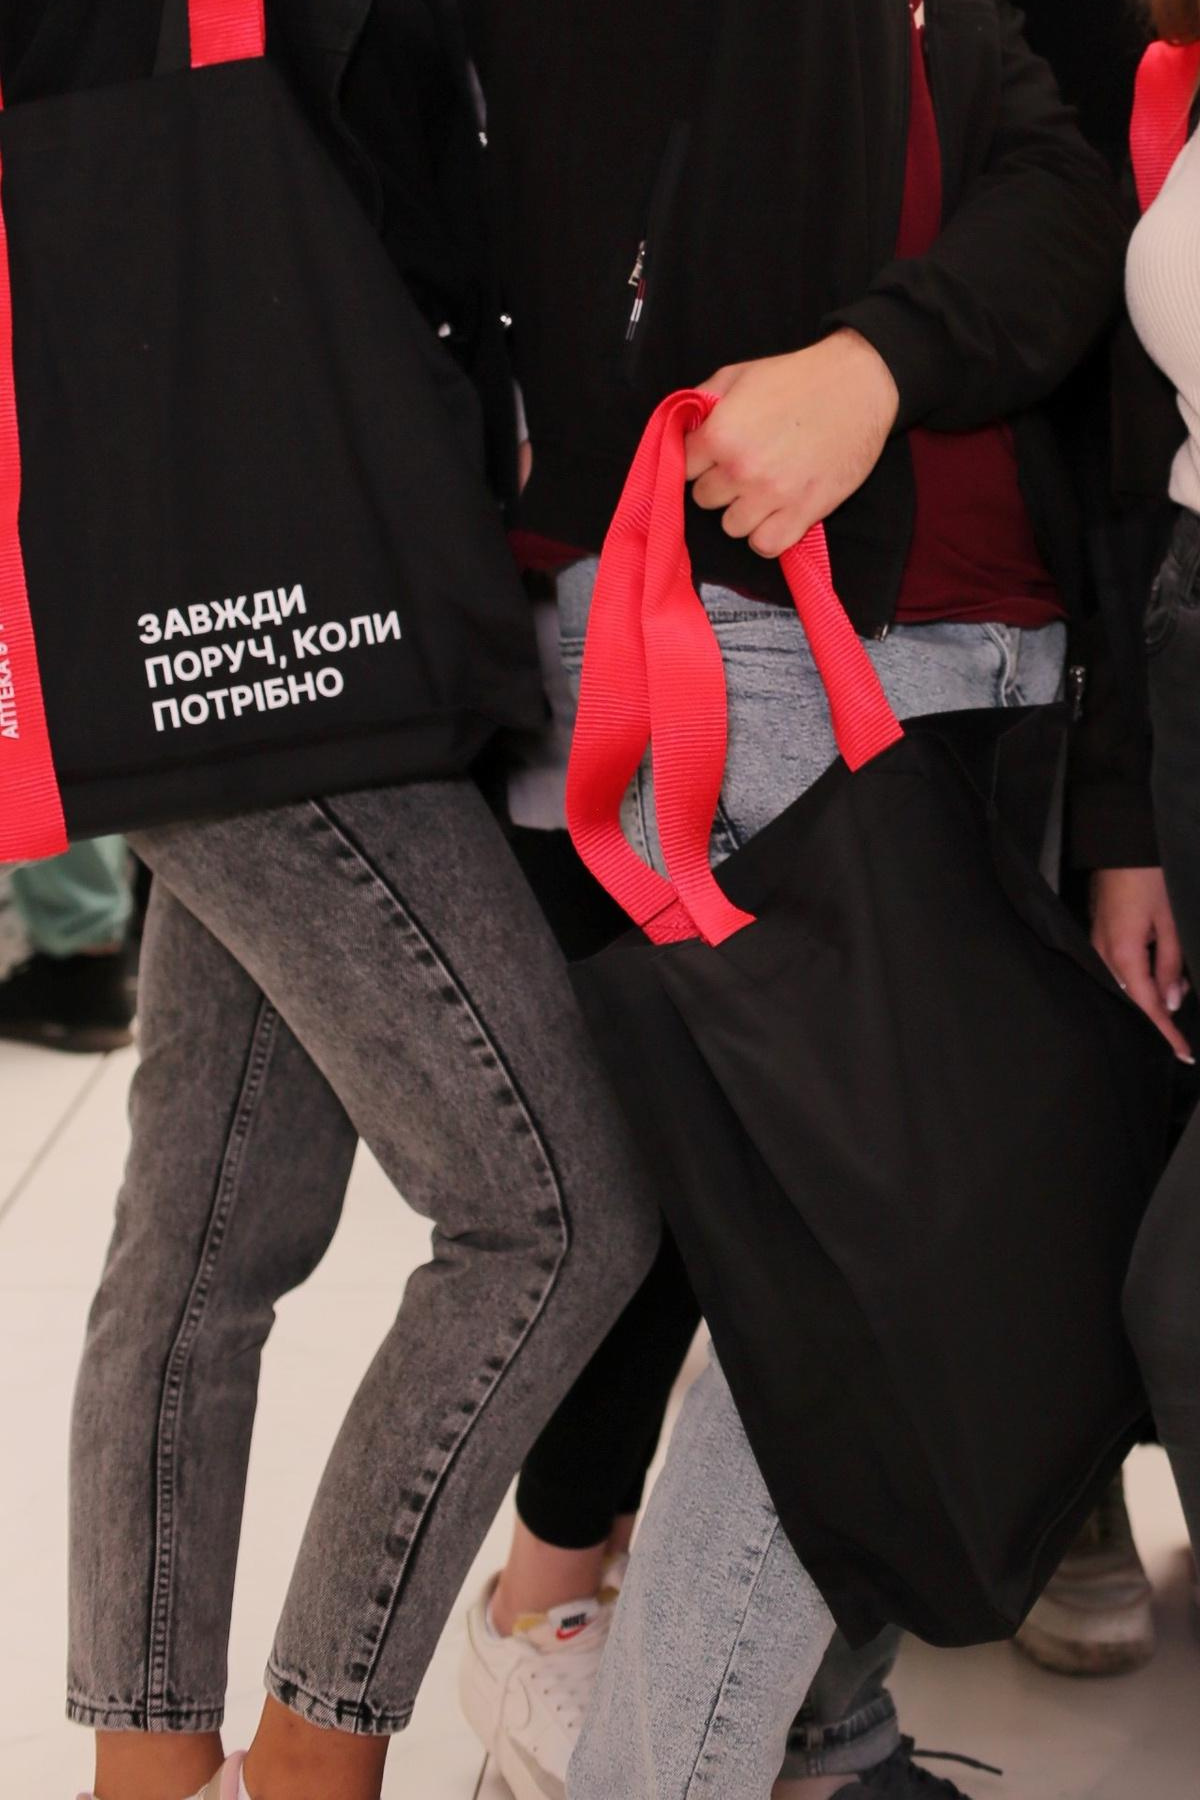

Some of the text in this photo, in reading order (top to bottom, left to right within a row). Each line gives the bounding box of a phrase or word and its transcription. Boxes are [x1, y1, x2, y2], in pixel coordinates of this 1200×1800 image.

[137, 584, 307, 644] ЗАВЖДИ
[144, 610, 402, 688] ПОРУЧ, КОЛИ
[152, 667, 344, 732] ПОТРІБНО
